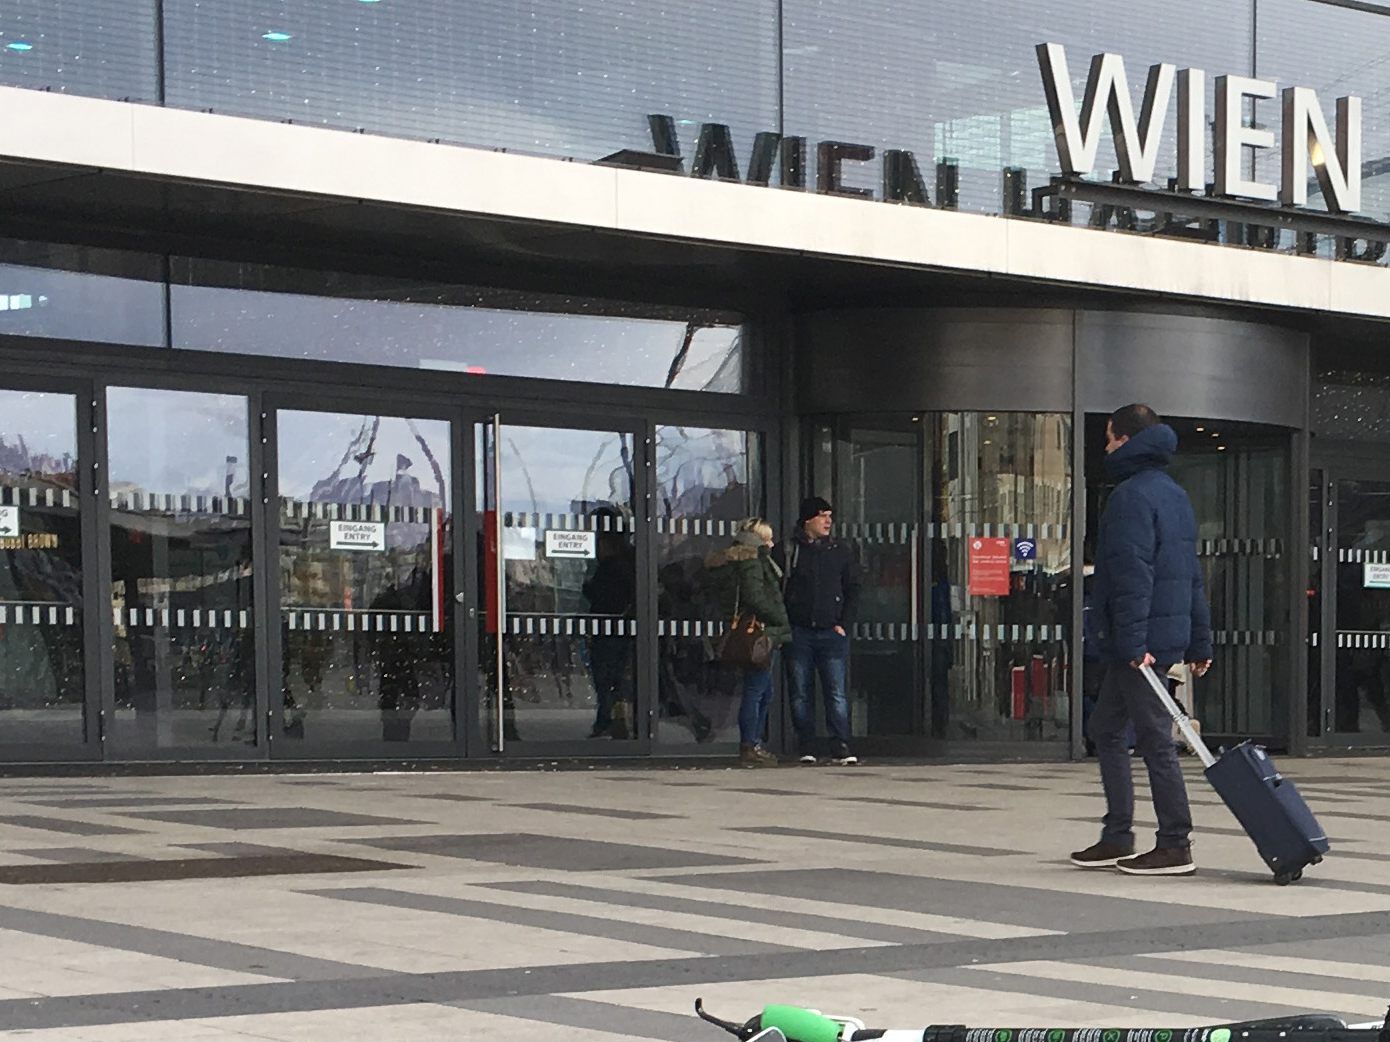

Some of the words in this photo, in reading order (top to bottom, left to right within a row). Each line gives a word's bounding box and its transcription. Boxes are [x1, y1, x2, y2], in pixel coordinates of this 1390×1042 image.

[1036, 42, 1362, 213] WIEN
[343, 532, 371, 540] ENTRY
[553, 533, 588, 541] EINGANG
